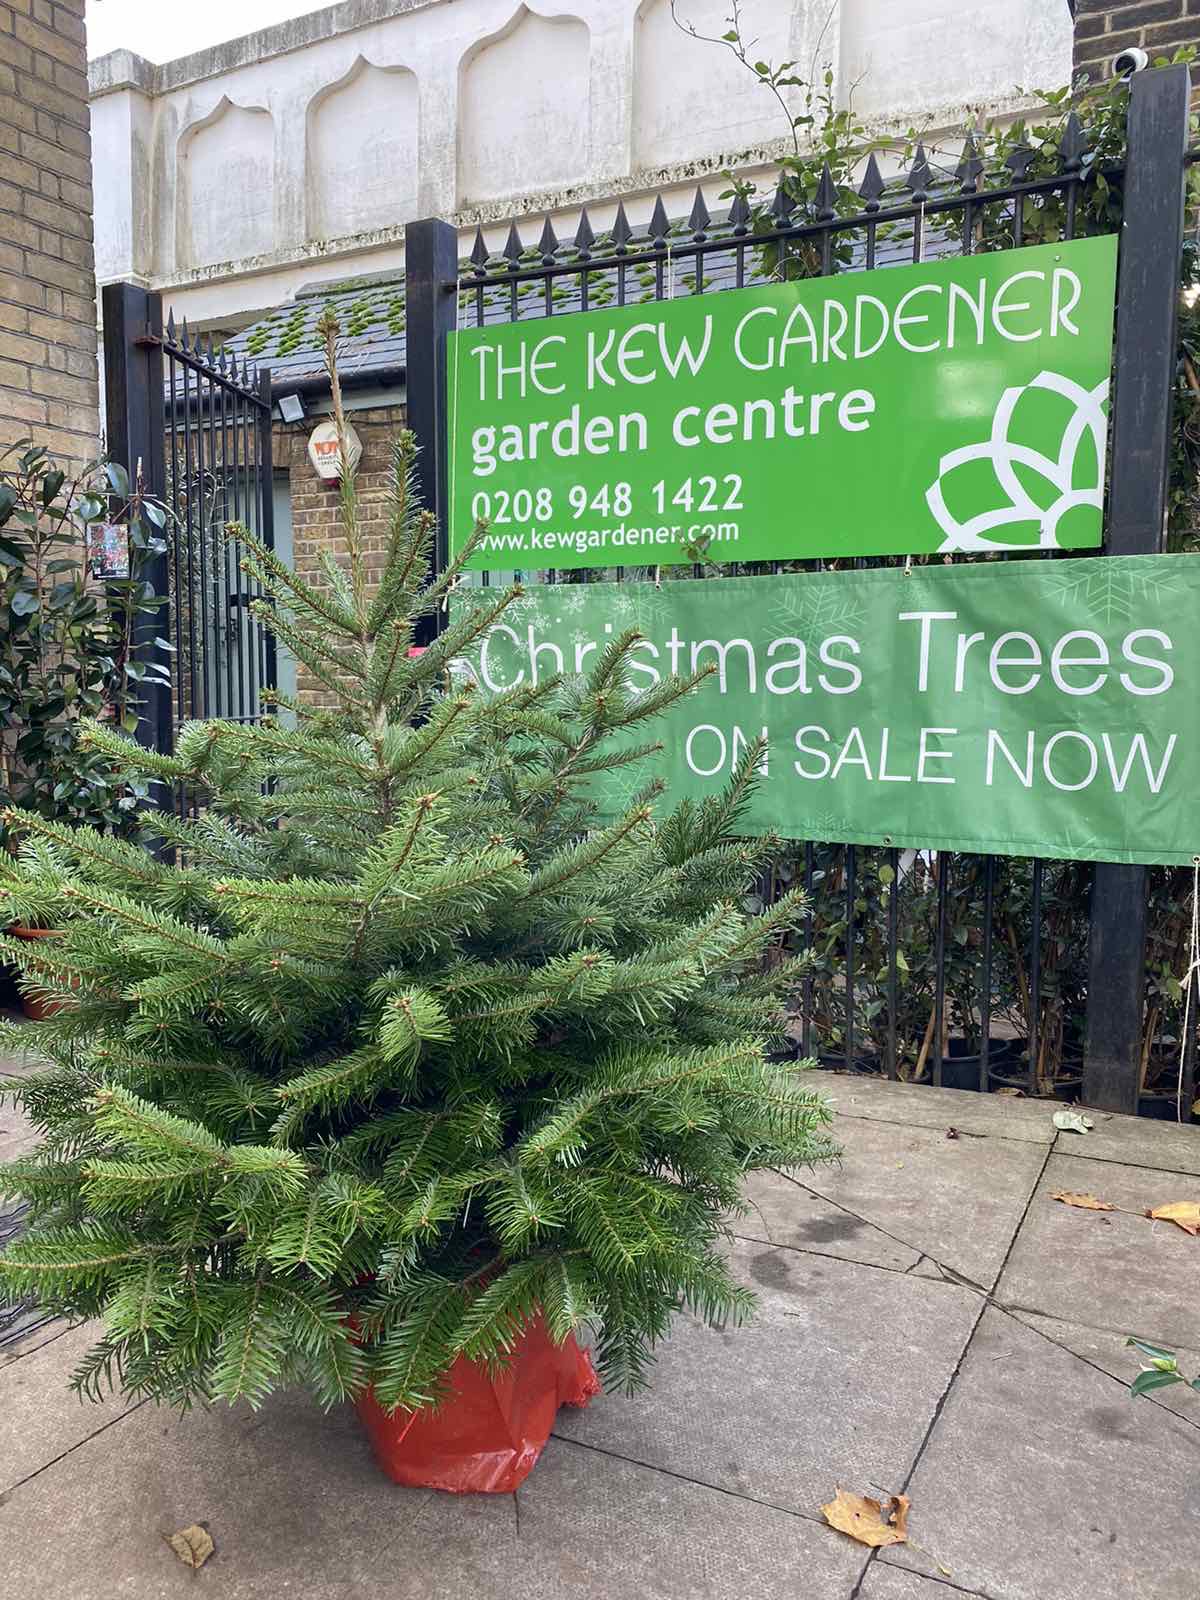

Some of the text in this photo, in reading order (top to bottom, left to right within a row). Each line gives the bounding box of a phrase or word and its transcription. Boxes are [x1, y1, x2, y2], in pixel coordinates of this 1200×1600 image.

[470, 267, 1083, 401] THE KEW GARDENER
[471, 385, 876, 477] garden centre
[471, 473, 744, 524] 0208 948 1422
[479, 611, 1176, 696] Chrstmas Trees
[685, 724, 1178, 795] ON SALE NOW
